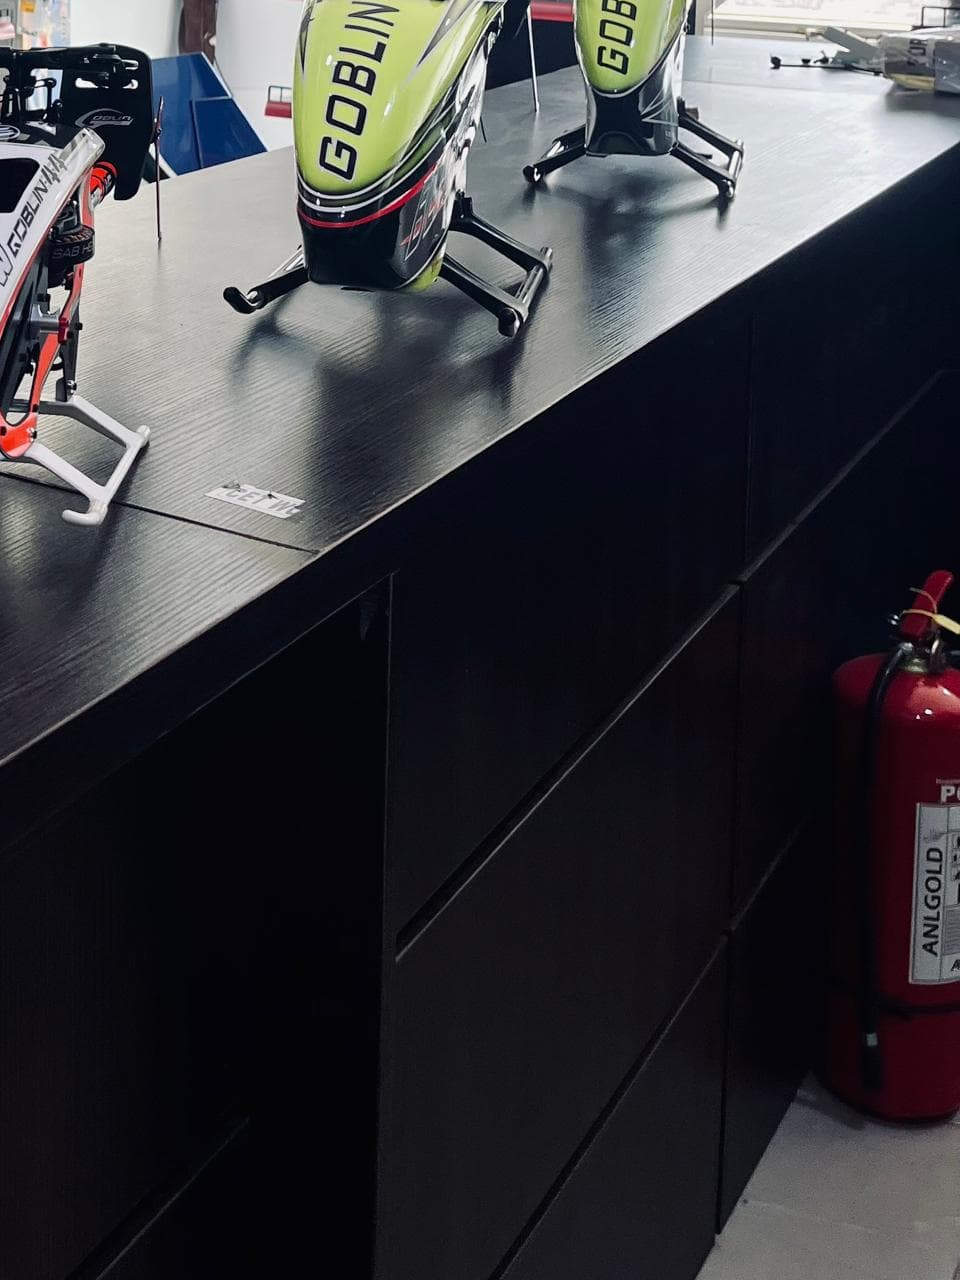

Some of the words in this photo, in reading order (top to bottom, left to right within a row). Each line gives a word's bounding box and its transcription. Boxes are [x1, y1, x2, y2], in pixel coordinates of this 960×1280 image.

[319, 0, 400, 181] GOBLIN
[7, 179, 48, 257] GOBLIN
[940, 785, 960, 804] P
[922, 847, 943, 957] ANLGOLD
